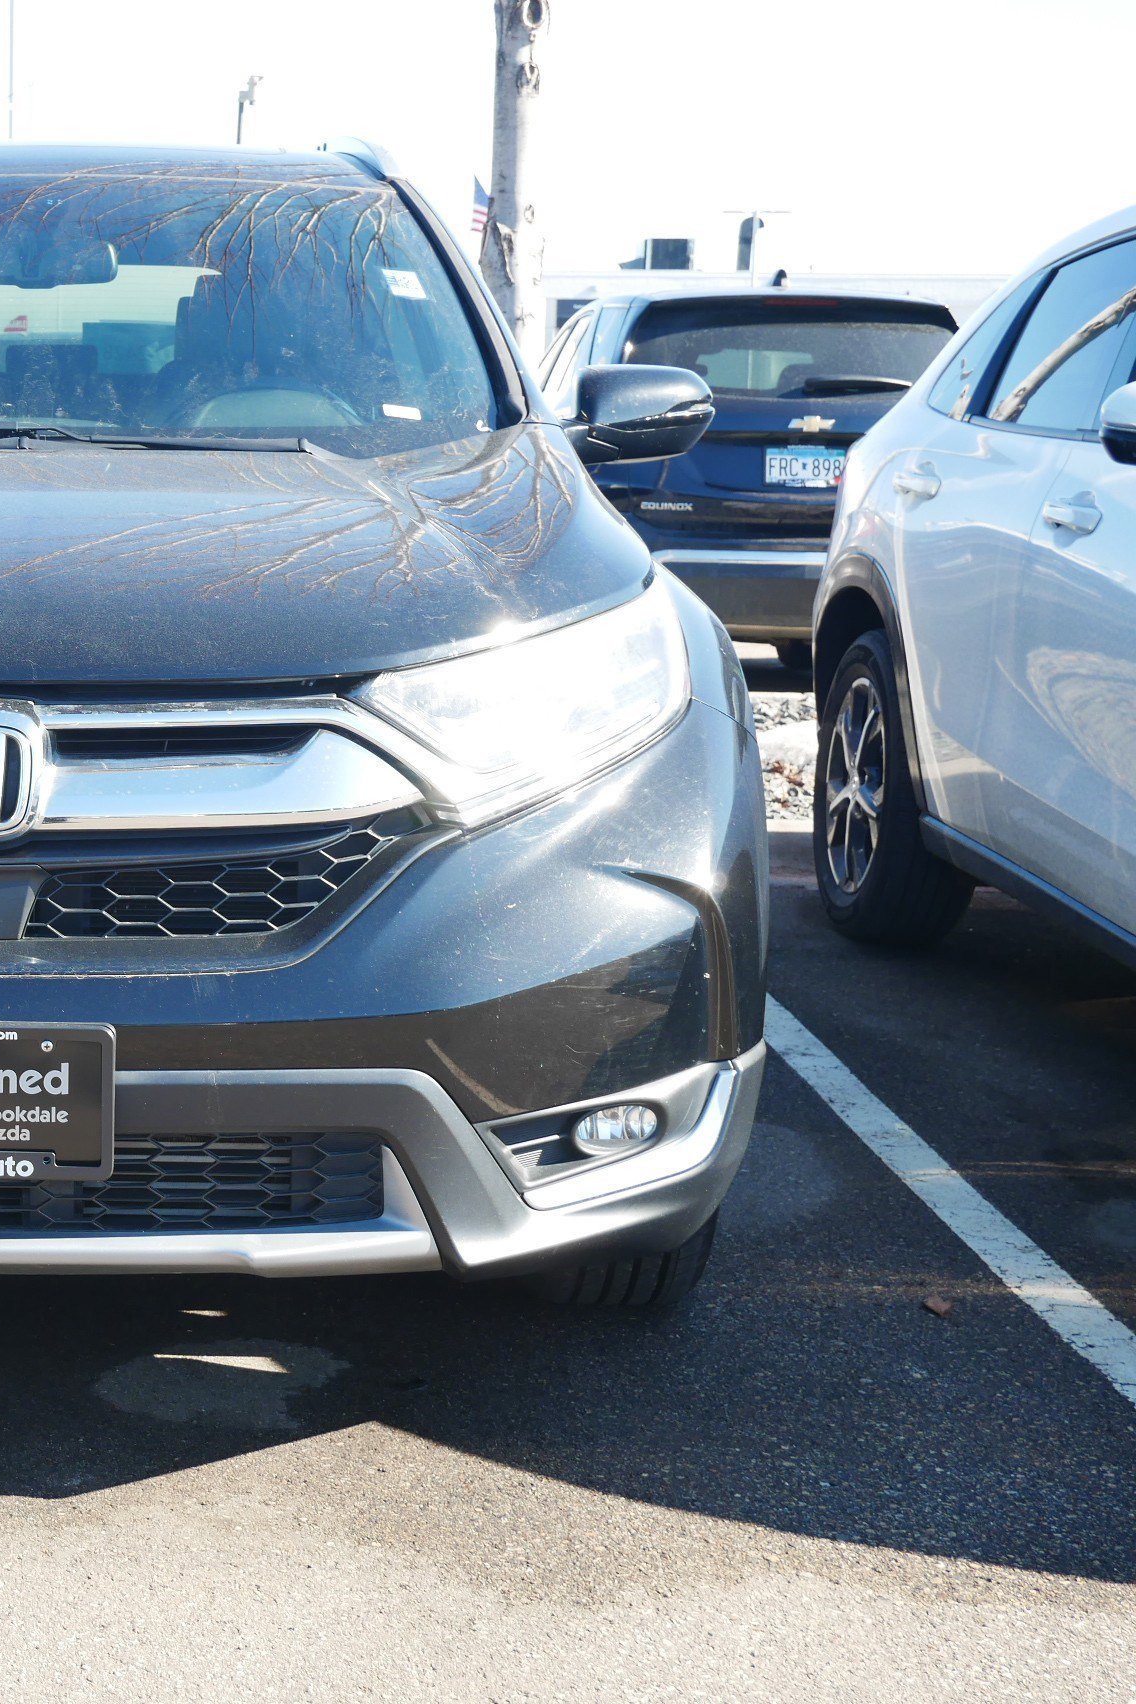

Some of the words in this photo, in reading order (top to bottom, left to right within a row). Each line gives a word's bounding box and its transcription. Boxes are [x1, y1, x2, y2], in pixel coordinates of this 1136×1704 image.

[768, 457, 799, 477] FRC
[812, 458, 842, 477] 898
[640, 501, 694, 511] EQUINOX
